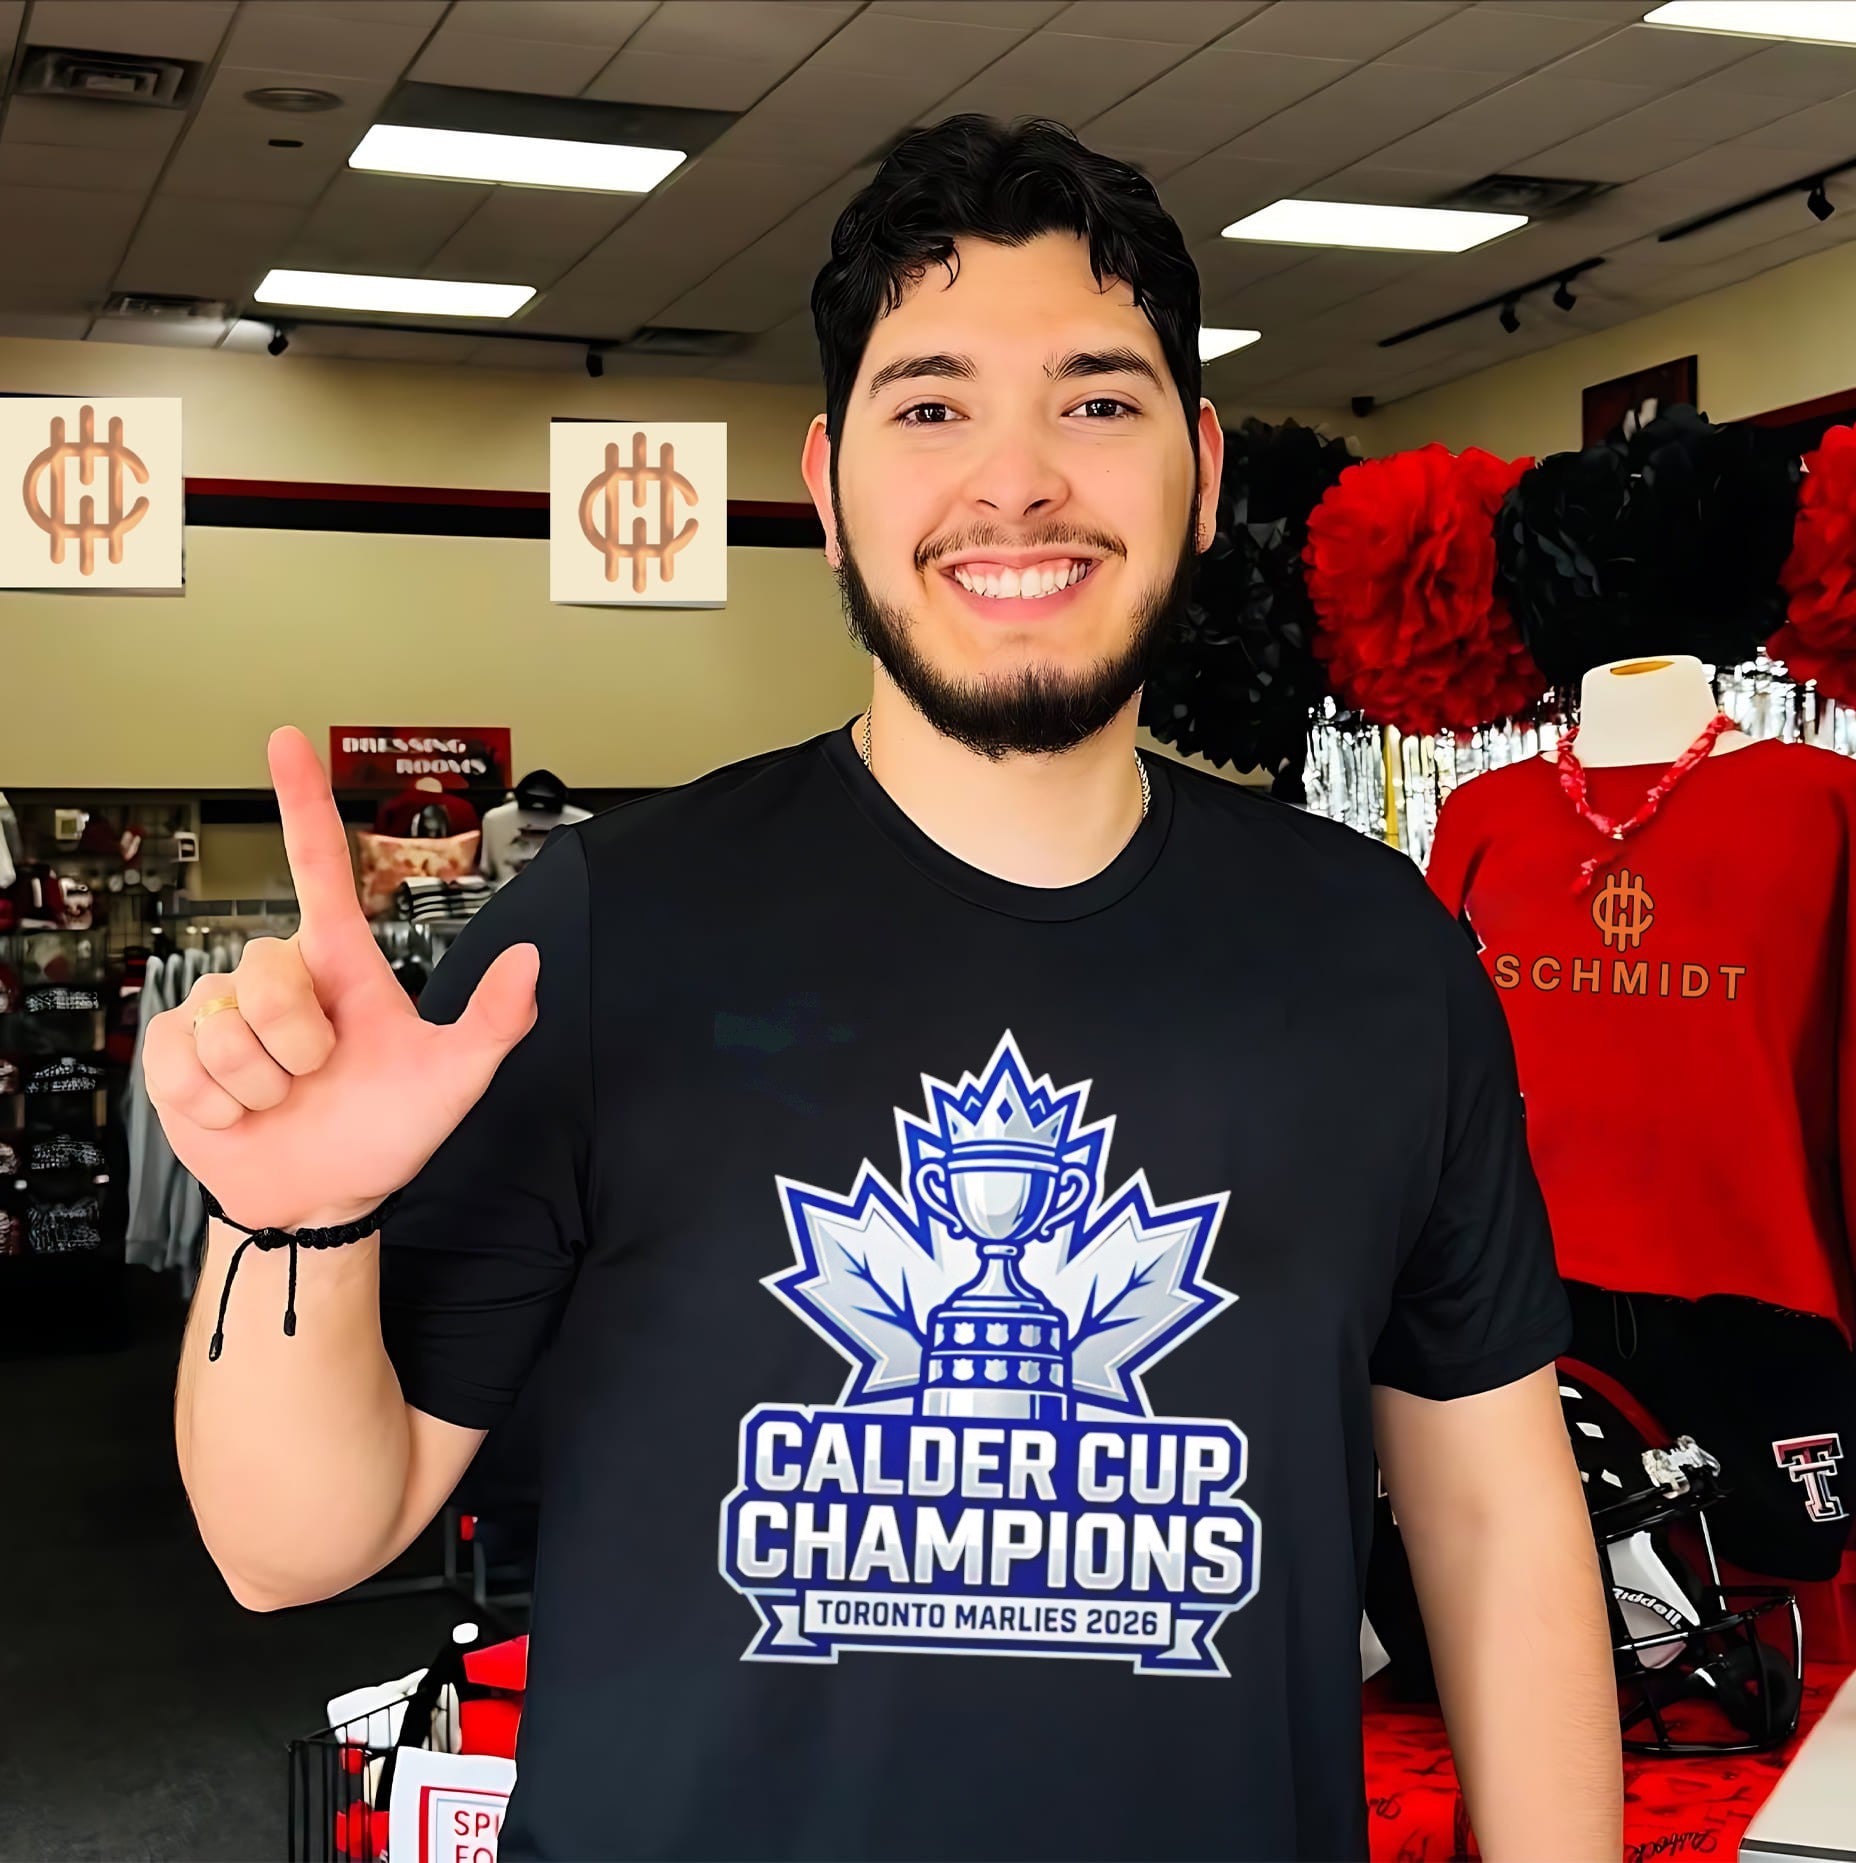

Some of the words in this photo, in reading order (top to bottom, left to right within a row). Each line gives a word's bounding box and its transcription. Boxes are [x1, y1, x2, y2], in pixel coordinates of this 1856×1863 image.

[395, 758, 487, 775] ROOMS
[1494, 953, 1747, 1001] SCHMIDT
[755, 1420, 1057, 1501] CALDER
[1077, 1432, 1231, 1506] CUP
[736, 1500, 1244, 1595] CHAMPIONS
[817, 1599, 945, 1630] TORONTO
[955, 1603, 1077, 1633] MARLIES
[1086, 1608, 1158, 1636] 2026
